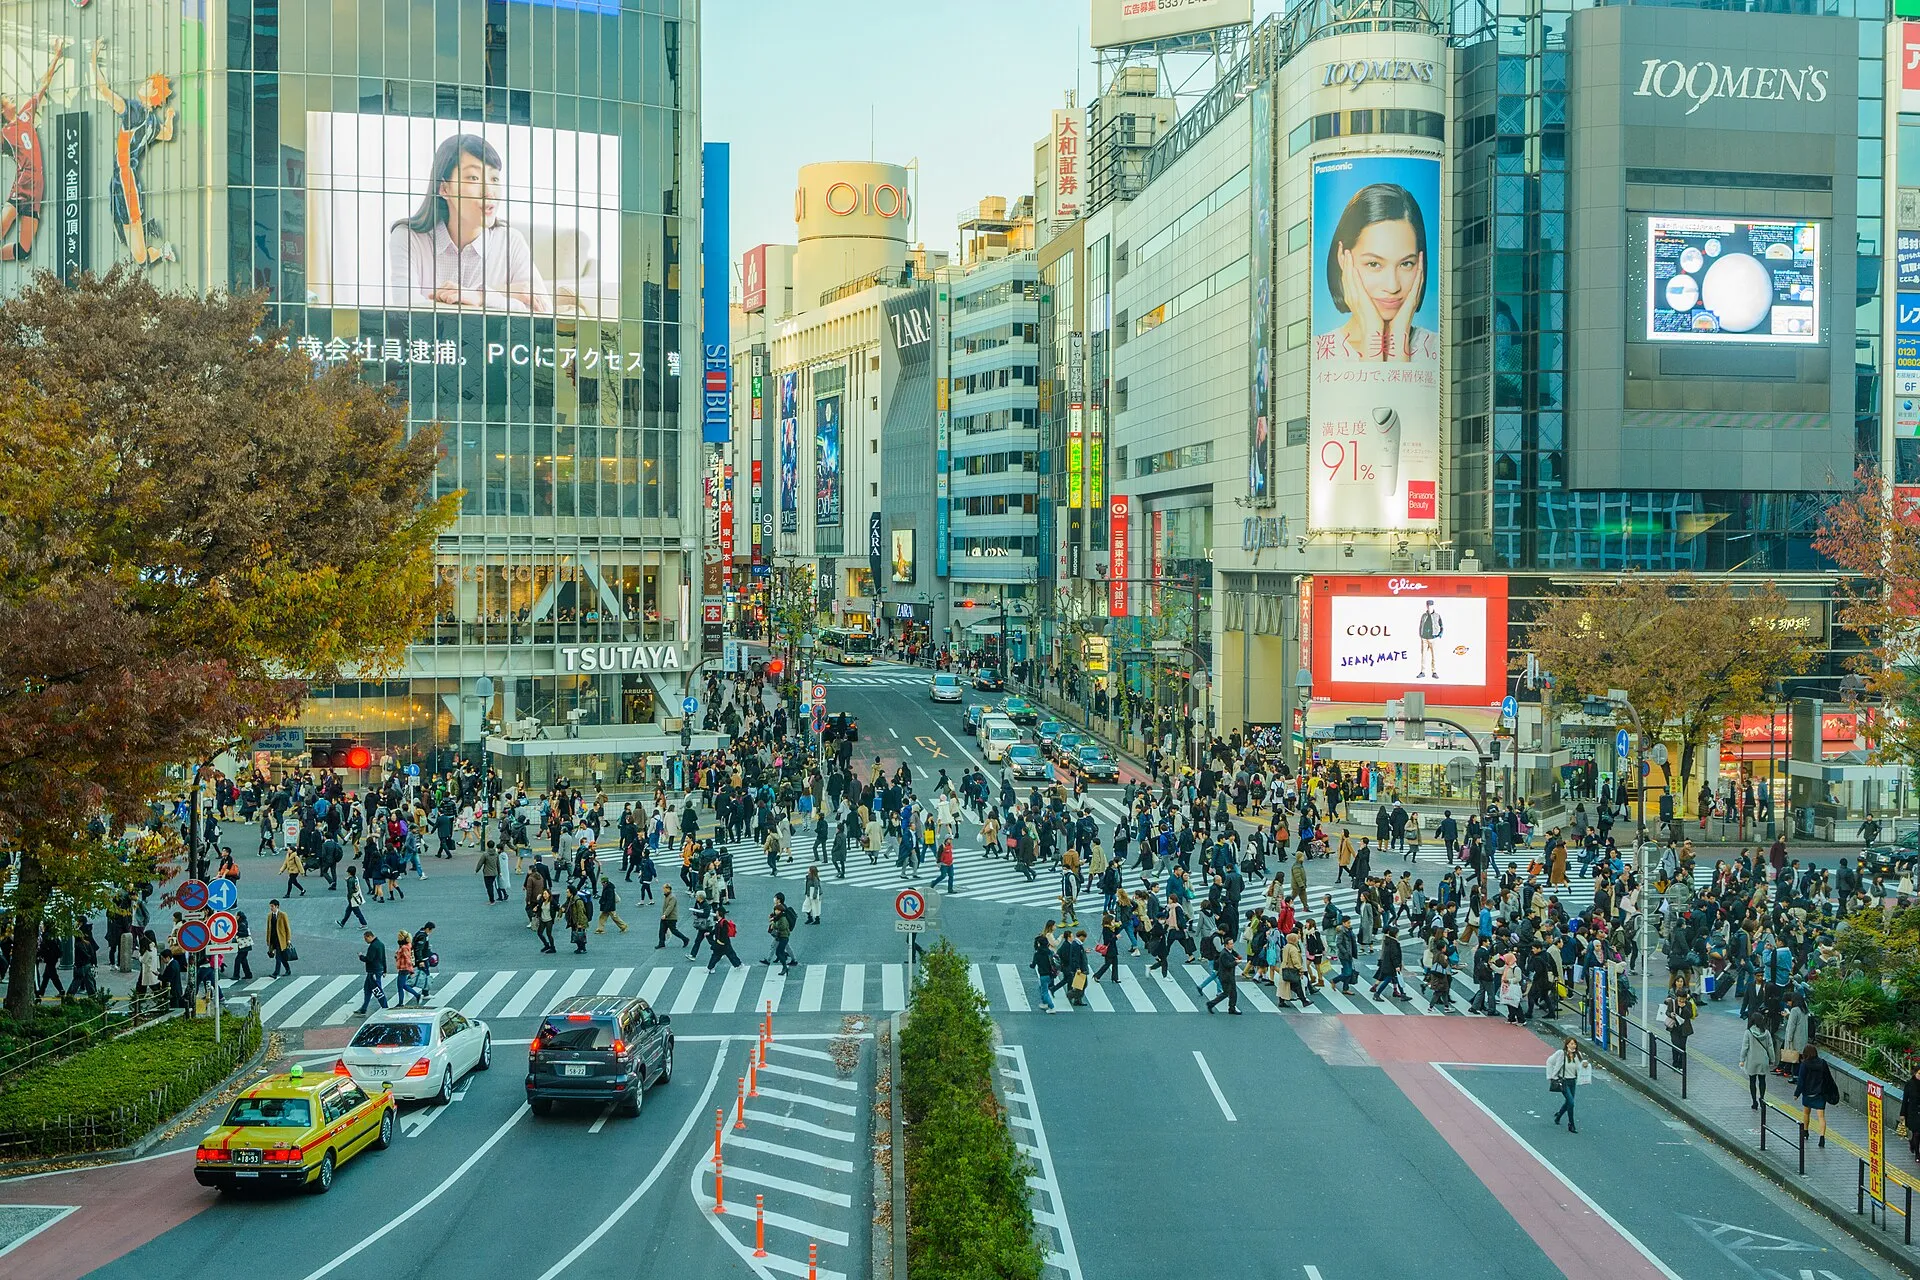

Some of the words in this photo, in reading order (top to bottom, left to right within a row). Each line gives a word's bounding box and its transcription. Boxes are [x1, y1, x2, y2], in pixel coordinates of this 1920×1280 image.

[1058, 117, 1078, 196] 大和証券
[1315, 162, 1353, 174] Panasonic
[1316, 330, 1437, 361] 深く、美しく。
[1898, 348, 1917, 357] 0120
[487, 343, 646, 373] PCにアクセス
[1904, 382, 1917, 392] 6F
[1321, 420, 1367, 437] 満足度
[1321, 440, 1375, 481] 91%
[1409, 490, 1435, 500] Panasonic
[1409, 500, 1429, 511] Beauty
[871, 519, 880, 556] ZARA
[1388, 578, 1428, 595] Glico
[706, 607, 720, 620] 本
[897, 603, 914, 618] ZARA
[1347, 624, 1391, 637] COOL
[562, 646, 680, 671] TSUTAYA
[1341, 653, 1375, 667] JEANS
[1377, 650, 1408, 663] MATE
[897, 923, 923, 931] ここから
[1869, 1100, 1879, 1195] 駐停車禁止
